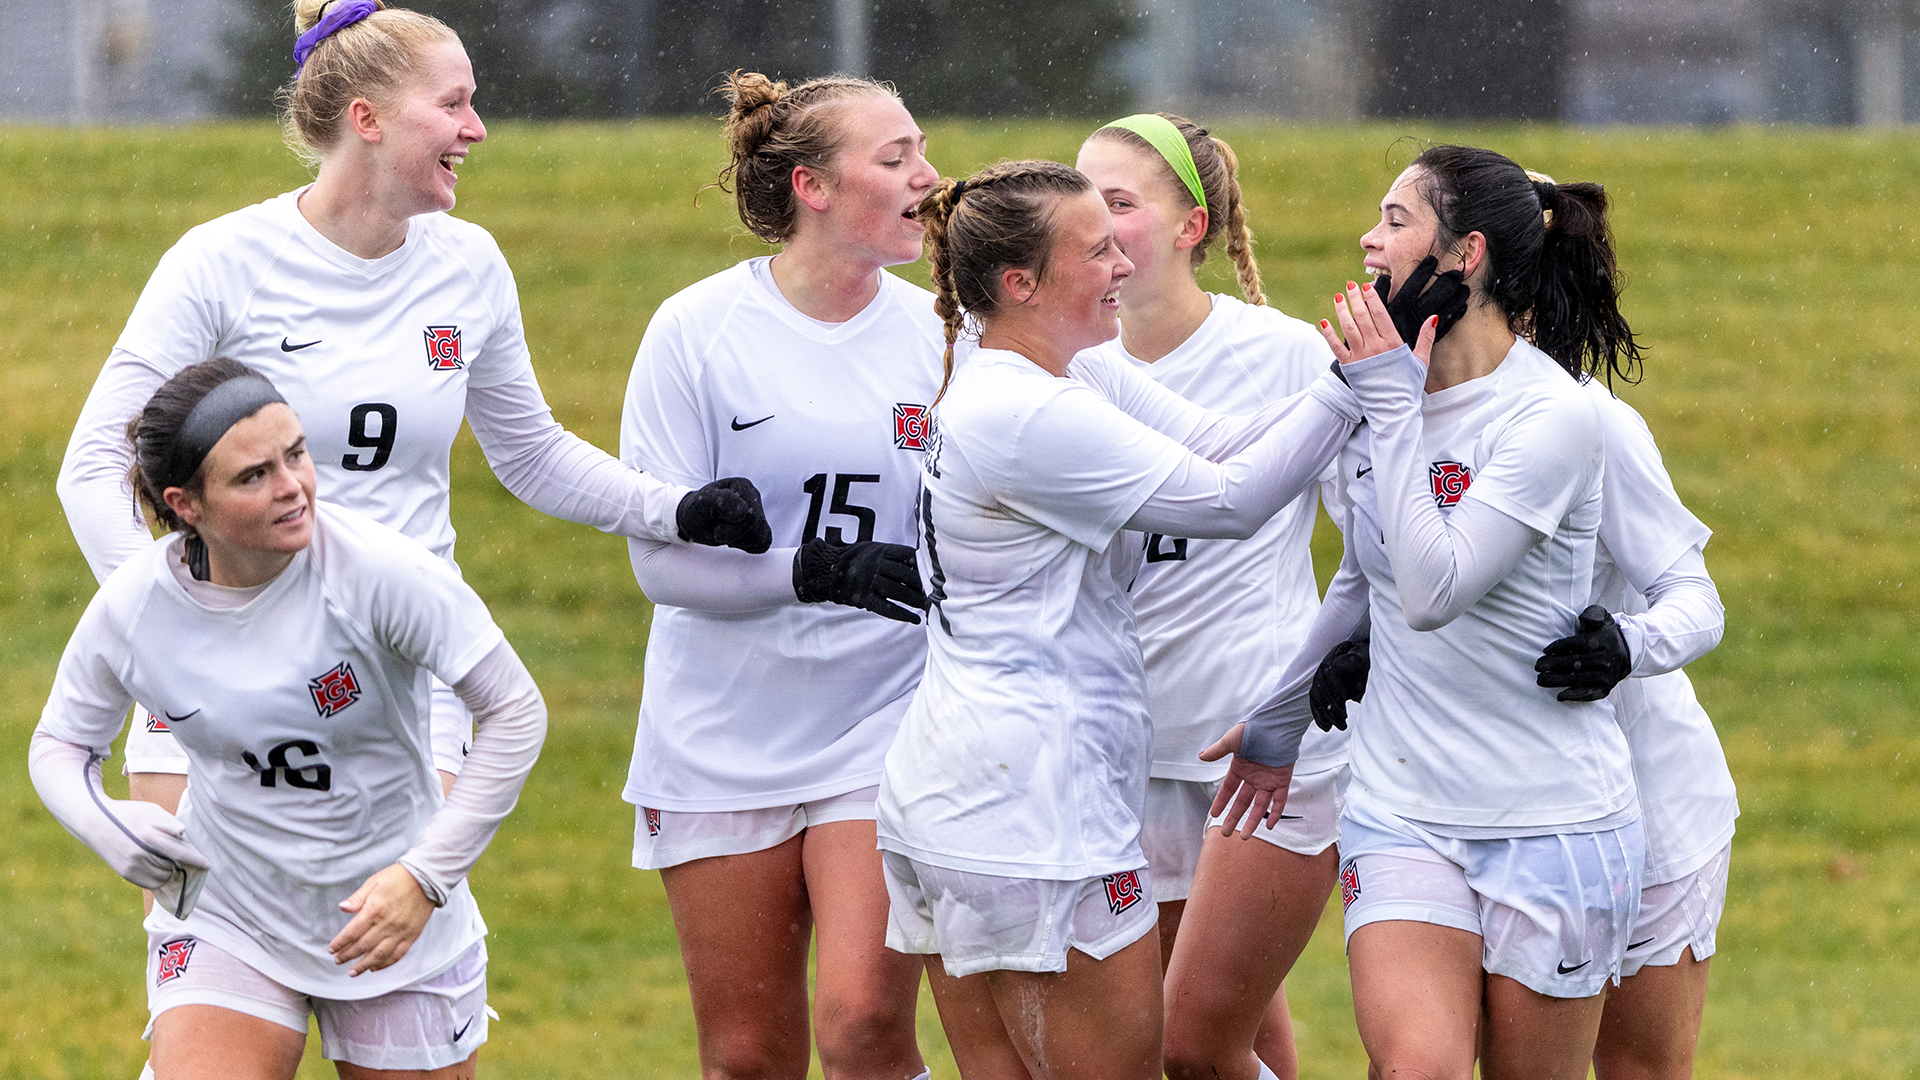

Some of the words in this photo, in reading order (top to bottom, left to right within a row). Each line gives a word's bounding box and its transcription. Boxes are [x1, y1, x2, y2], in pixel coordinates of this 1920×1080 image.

[436, 337, 453, 359] G
[342, 403, 397, 470] 9
[905, 416, 921, 438] G
[1441, 474, 1463, 495] G
[801, 473, 880, 547] 15
[326, 678, 346, 702] G
[1115, 874, 1133, 896] G
[164, 949, 181, 971] G
